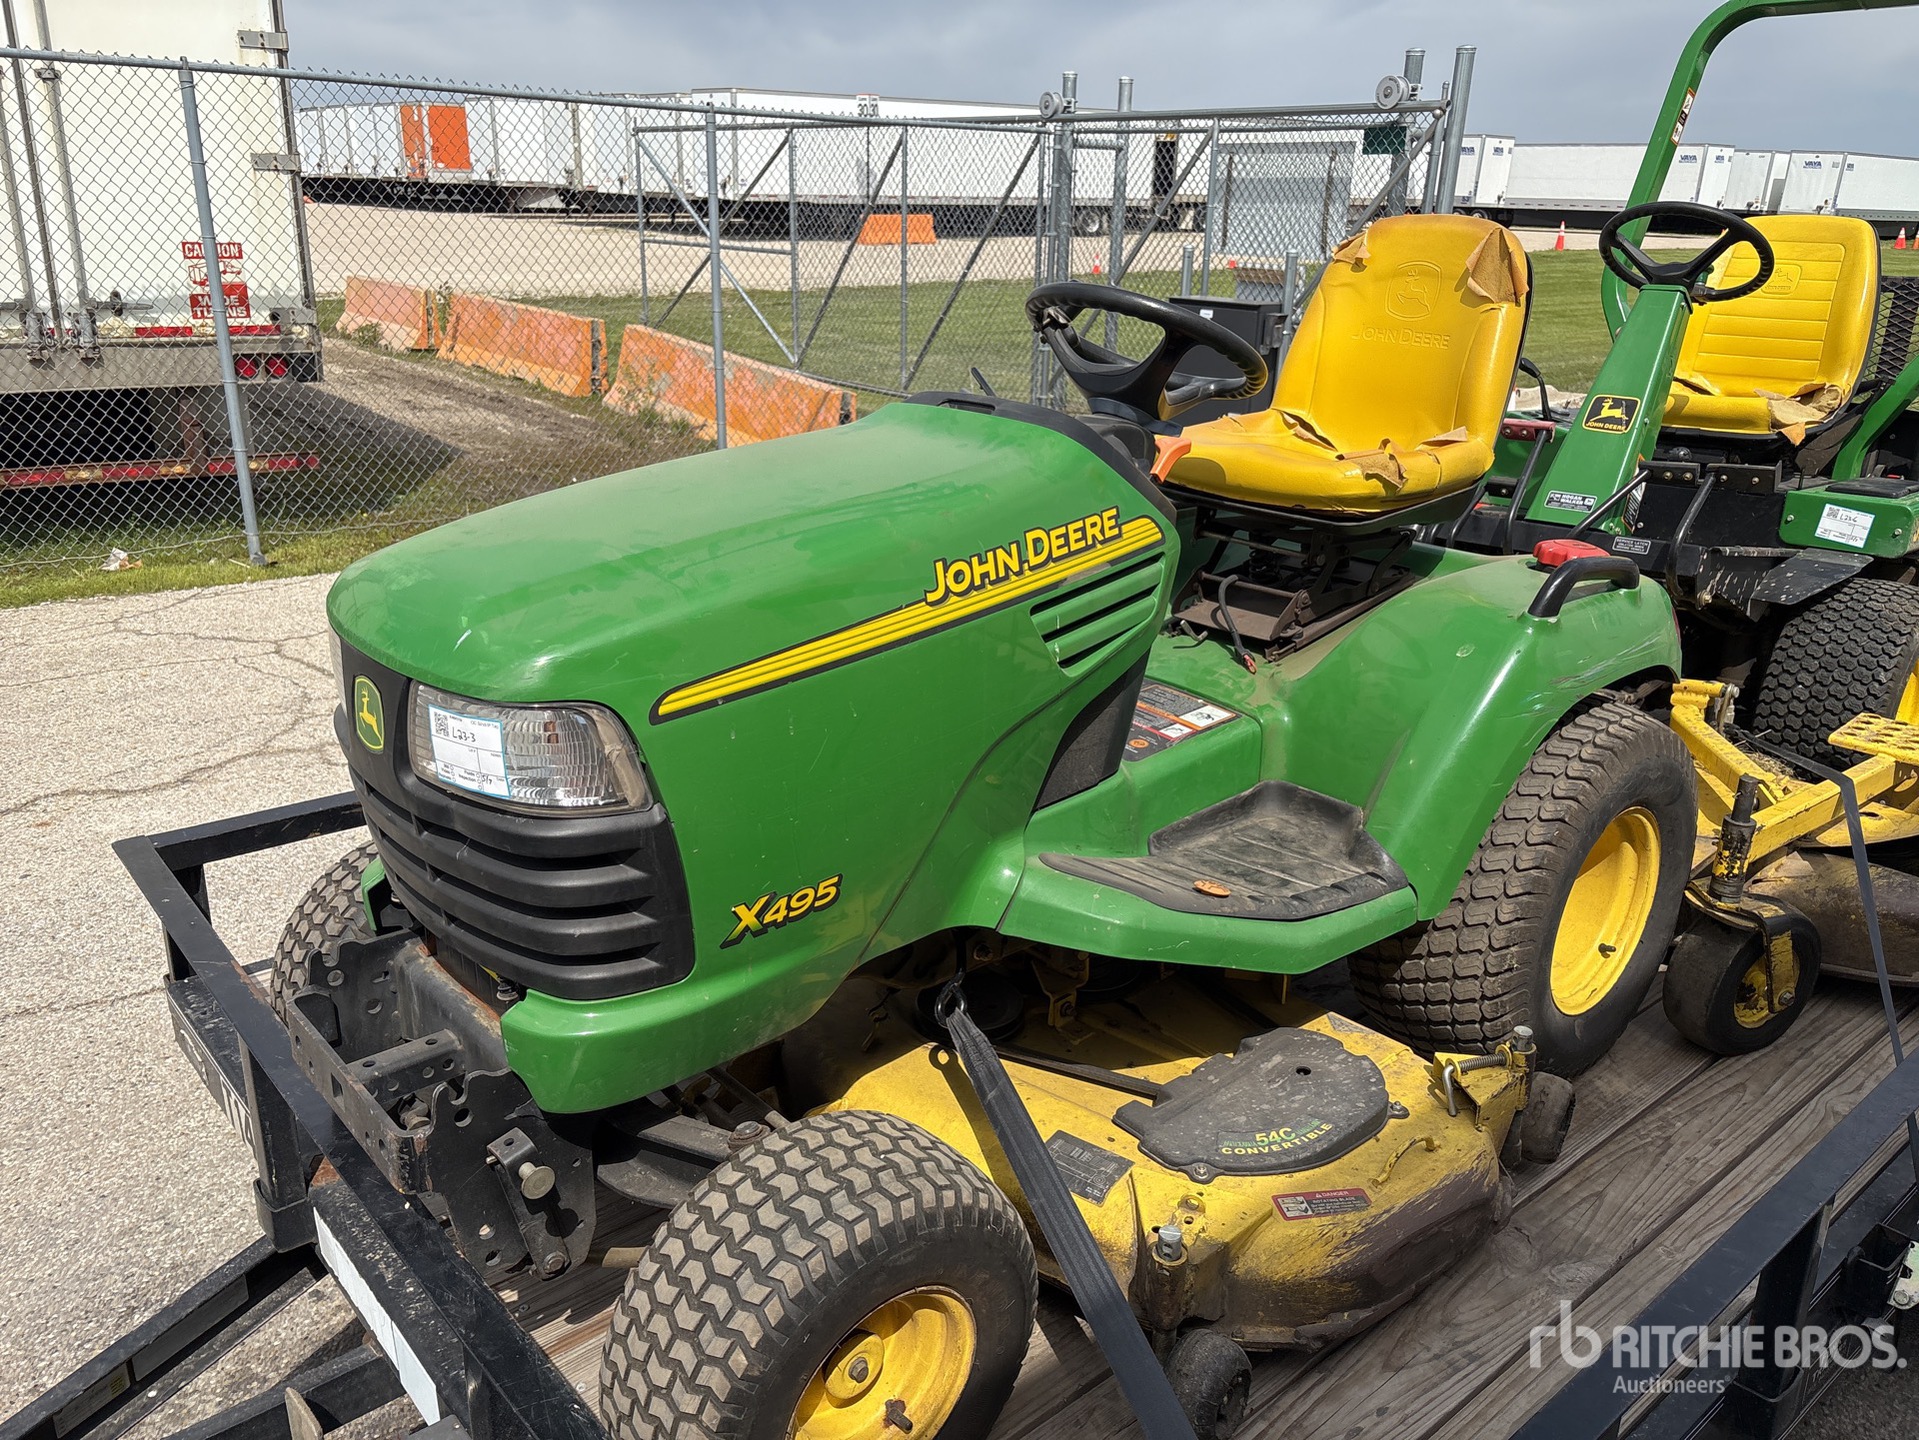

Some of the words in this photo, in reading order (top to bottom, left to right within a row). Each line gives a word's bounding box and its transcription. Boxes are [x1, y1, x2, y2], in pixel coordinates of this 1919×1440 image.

[184, 244, 239, 257] CAION
[1399, 328, 1450, 350] DEERE
[926, 541, 1020, 605] JOHN
[1024, 506, 1120, 568] DEERE
[452, 726, 476, 742] L23-3
[722, 874, 841, 946] X495
[1221, 1122, 1333, 1155] CONVERTIBLE
[1254, 1127, 1296, 1146] 54C
[1321, 1190, 1349, 1198] DANGER
